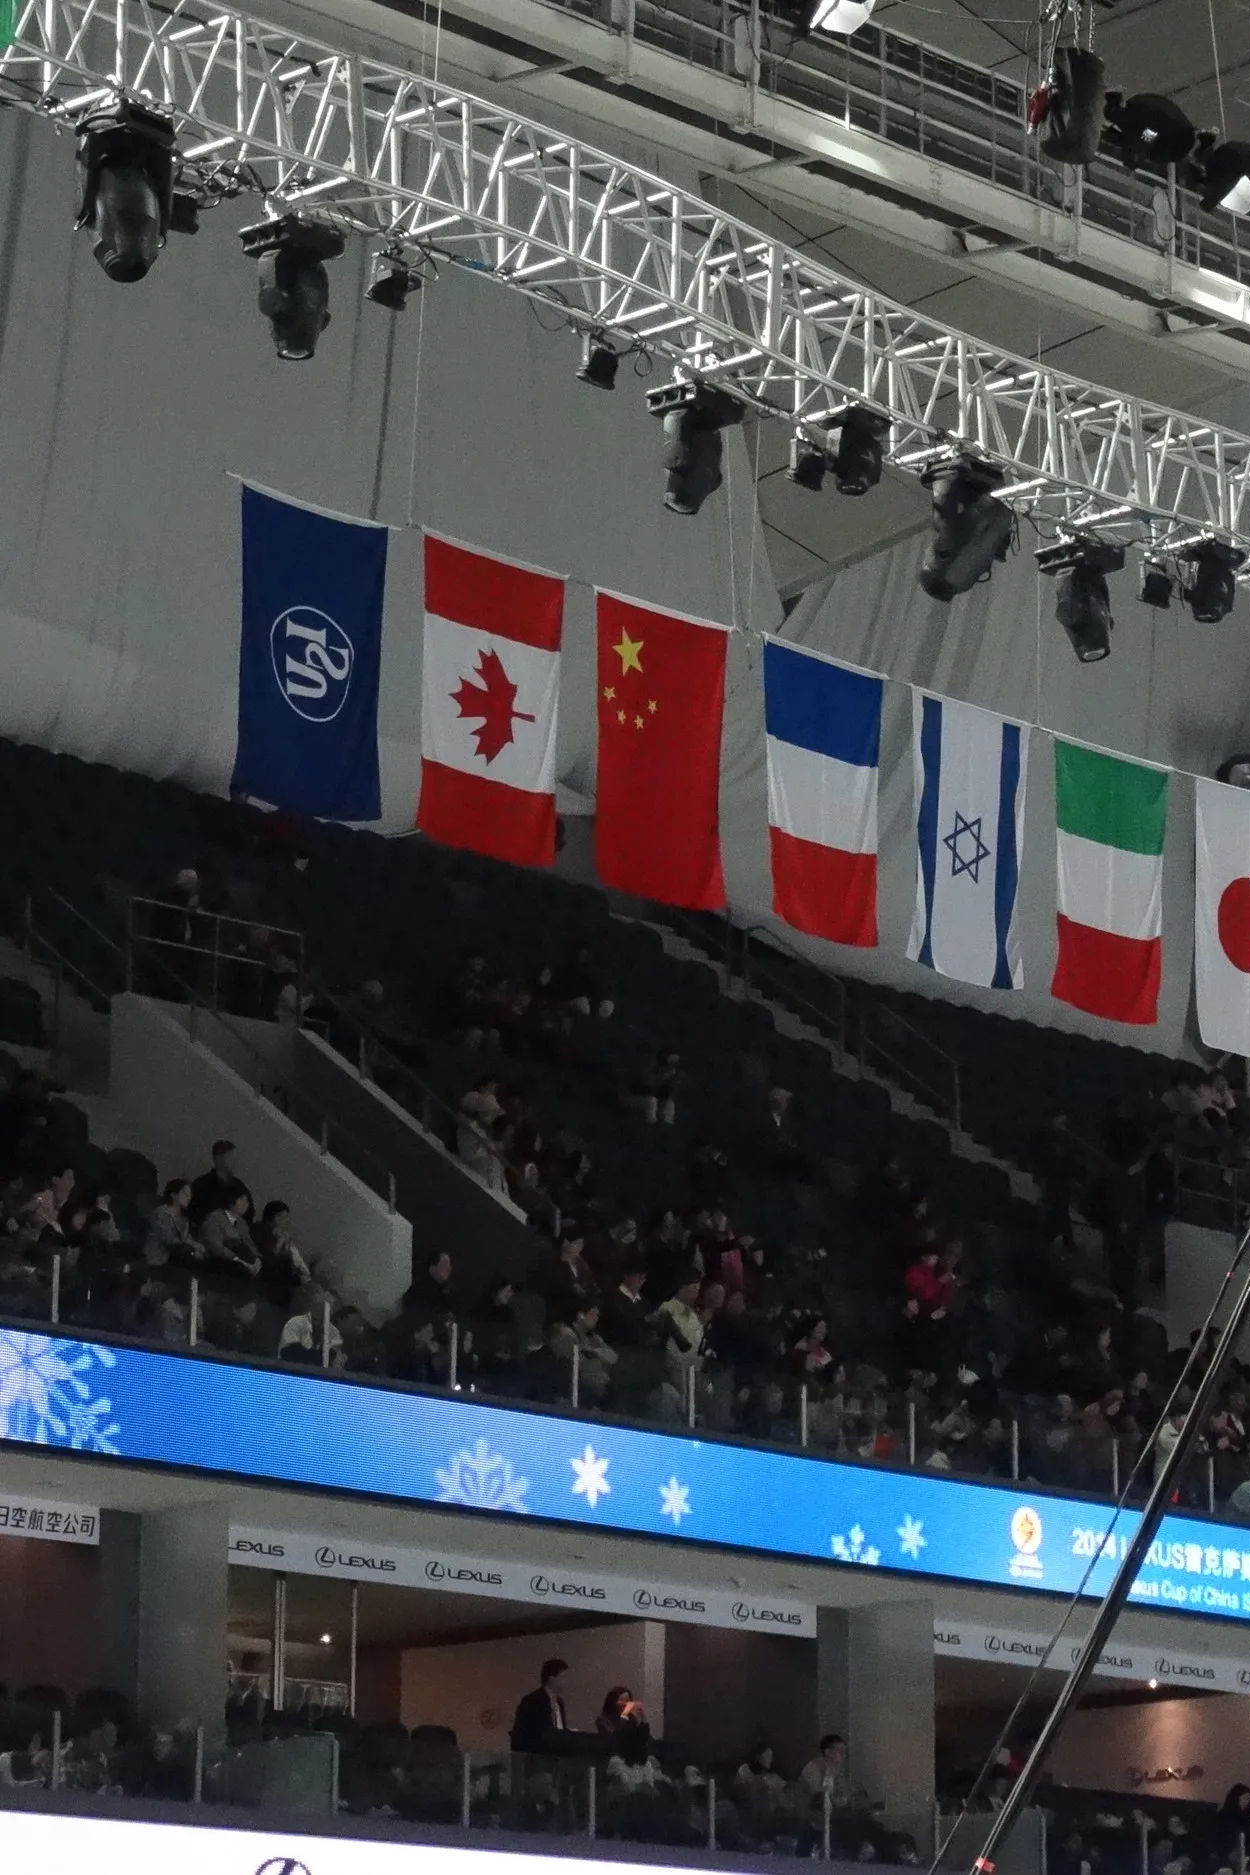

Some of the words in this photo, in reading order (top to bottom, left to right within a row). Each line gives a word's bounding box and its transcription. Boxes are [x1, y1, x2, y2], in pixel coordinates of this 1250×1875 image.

[338, 1554, 397, 1571] LEXUS
[447, 1568, 503, 1585] LEXUS
[551, 1582, 606, 1599] LEXUS
[653, 1597, 706, 1613] LEXUS
[751, 1610, 802, 1625] LEXUS
[1161, 1579, 1187, 1604] Cup
[933, 1634, 961, 1645] XUS
[1002, 1641, 1050, 1657] LEXUS
[1097, 1655, 1133, 1669] EXUS
[1171, 1663, 1216, 1679] LEXUS
